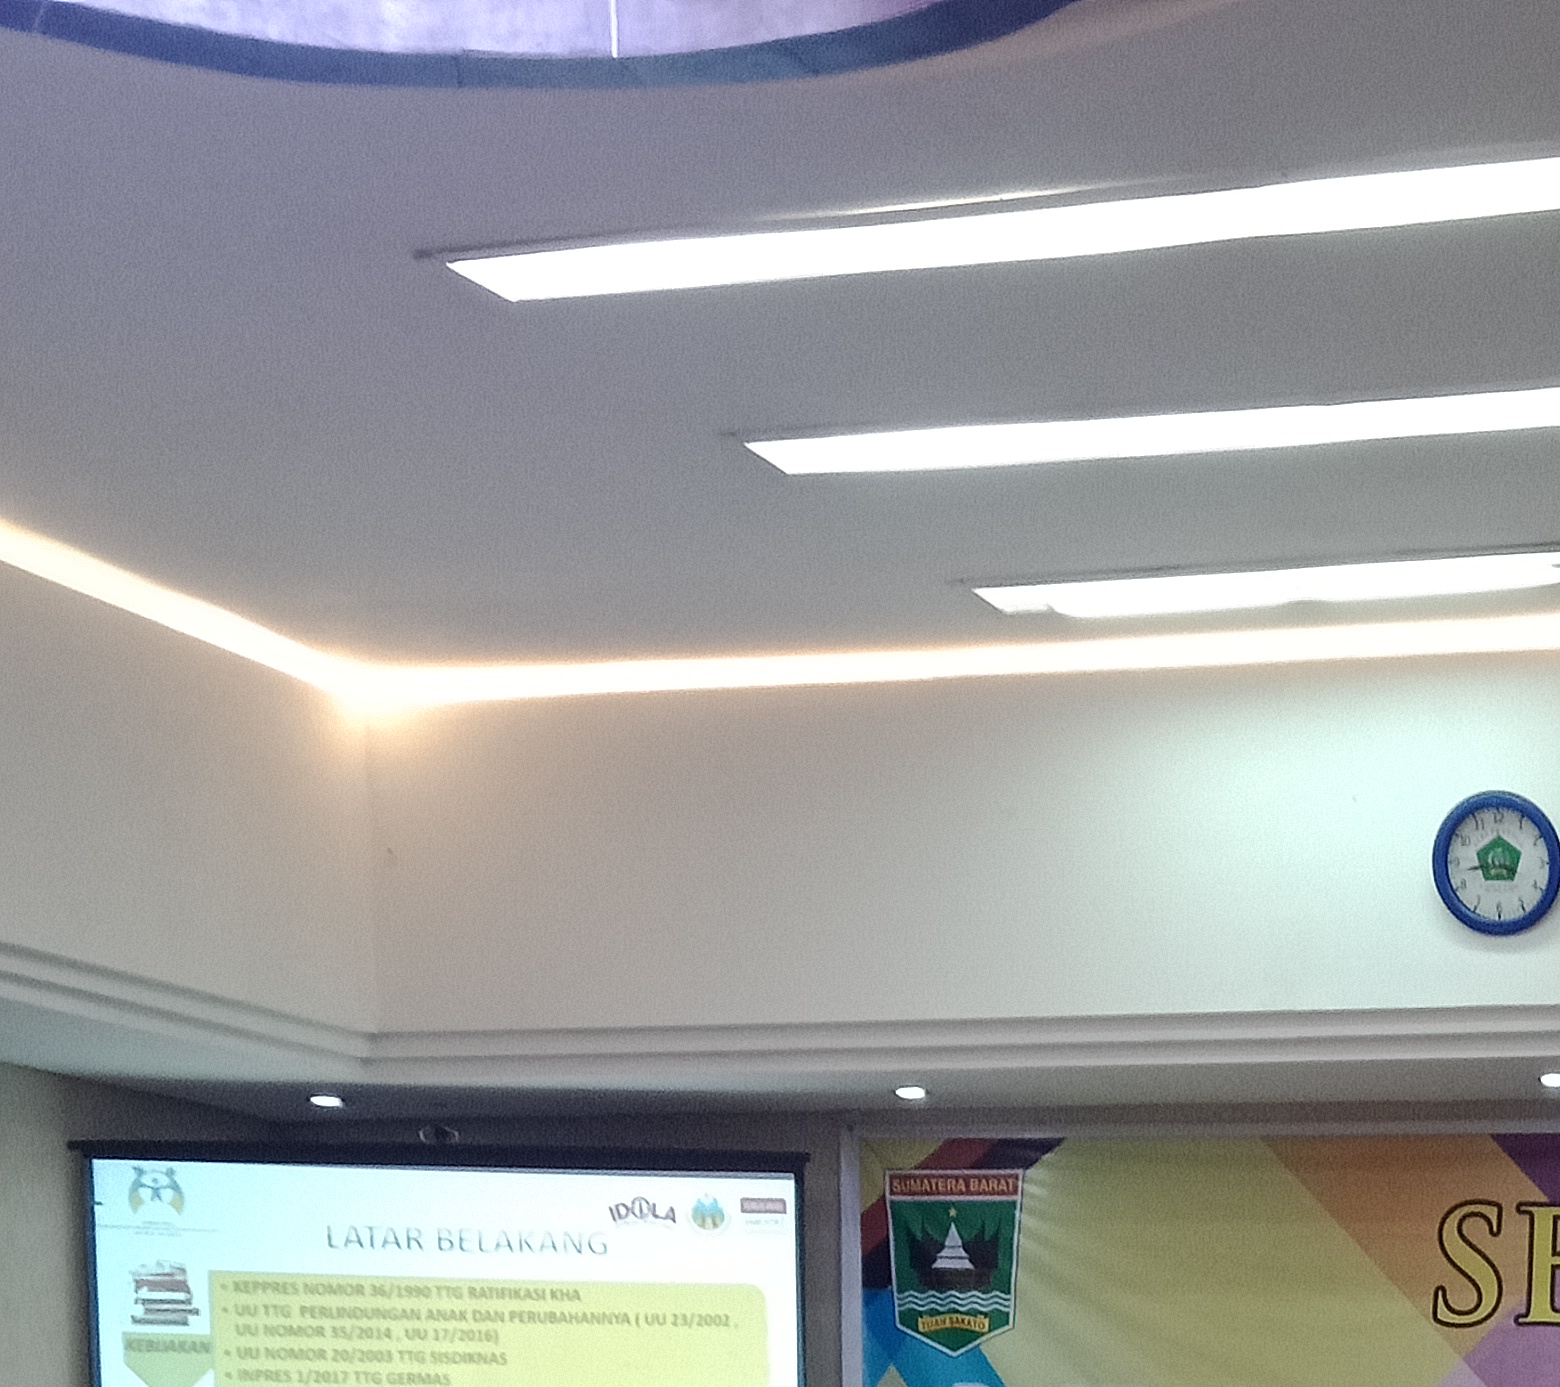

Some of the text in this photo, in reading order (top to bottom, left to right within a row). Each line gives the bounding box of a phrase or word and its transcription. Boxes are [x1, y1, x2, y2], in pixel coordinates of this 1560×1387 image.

[891, 1177, 1016, 1194] SUMATERA BARAT
[327, 1224, 609, 1256] LATAR BELAKANG
[303, 1282, 365, 1297] NOMOR
[435, 1285, 463, 1299] TTG
[468, 1286, 547, 1301] RATIFIKASI
[550, 1287, 582, 1302] KHA
[262, 1304, 291, 1318] TTG
[299, 1305, 421, 1320] PERLINDUNGAN
[425, 1308, 468, 1322] ANAK
[472, 1309, 505, 1323] DAN
[509, 1310, 631, 1326] PERUBAHANNYA
[263, 1323, 326, 1338] NOMOR
[264, 1347, 327, 1362] NOMOR
[397, 1350, 426, 1364] TTG
[354, 1371, 383, 1385] TTG
[386, 1371, 451, 1386] GERMAS
